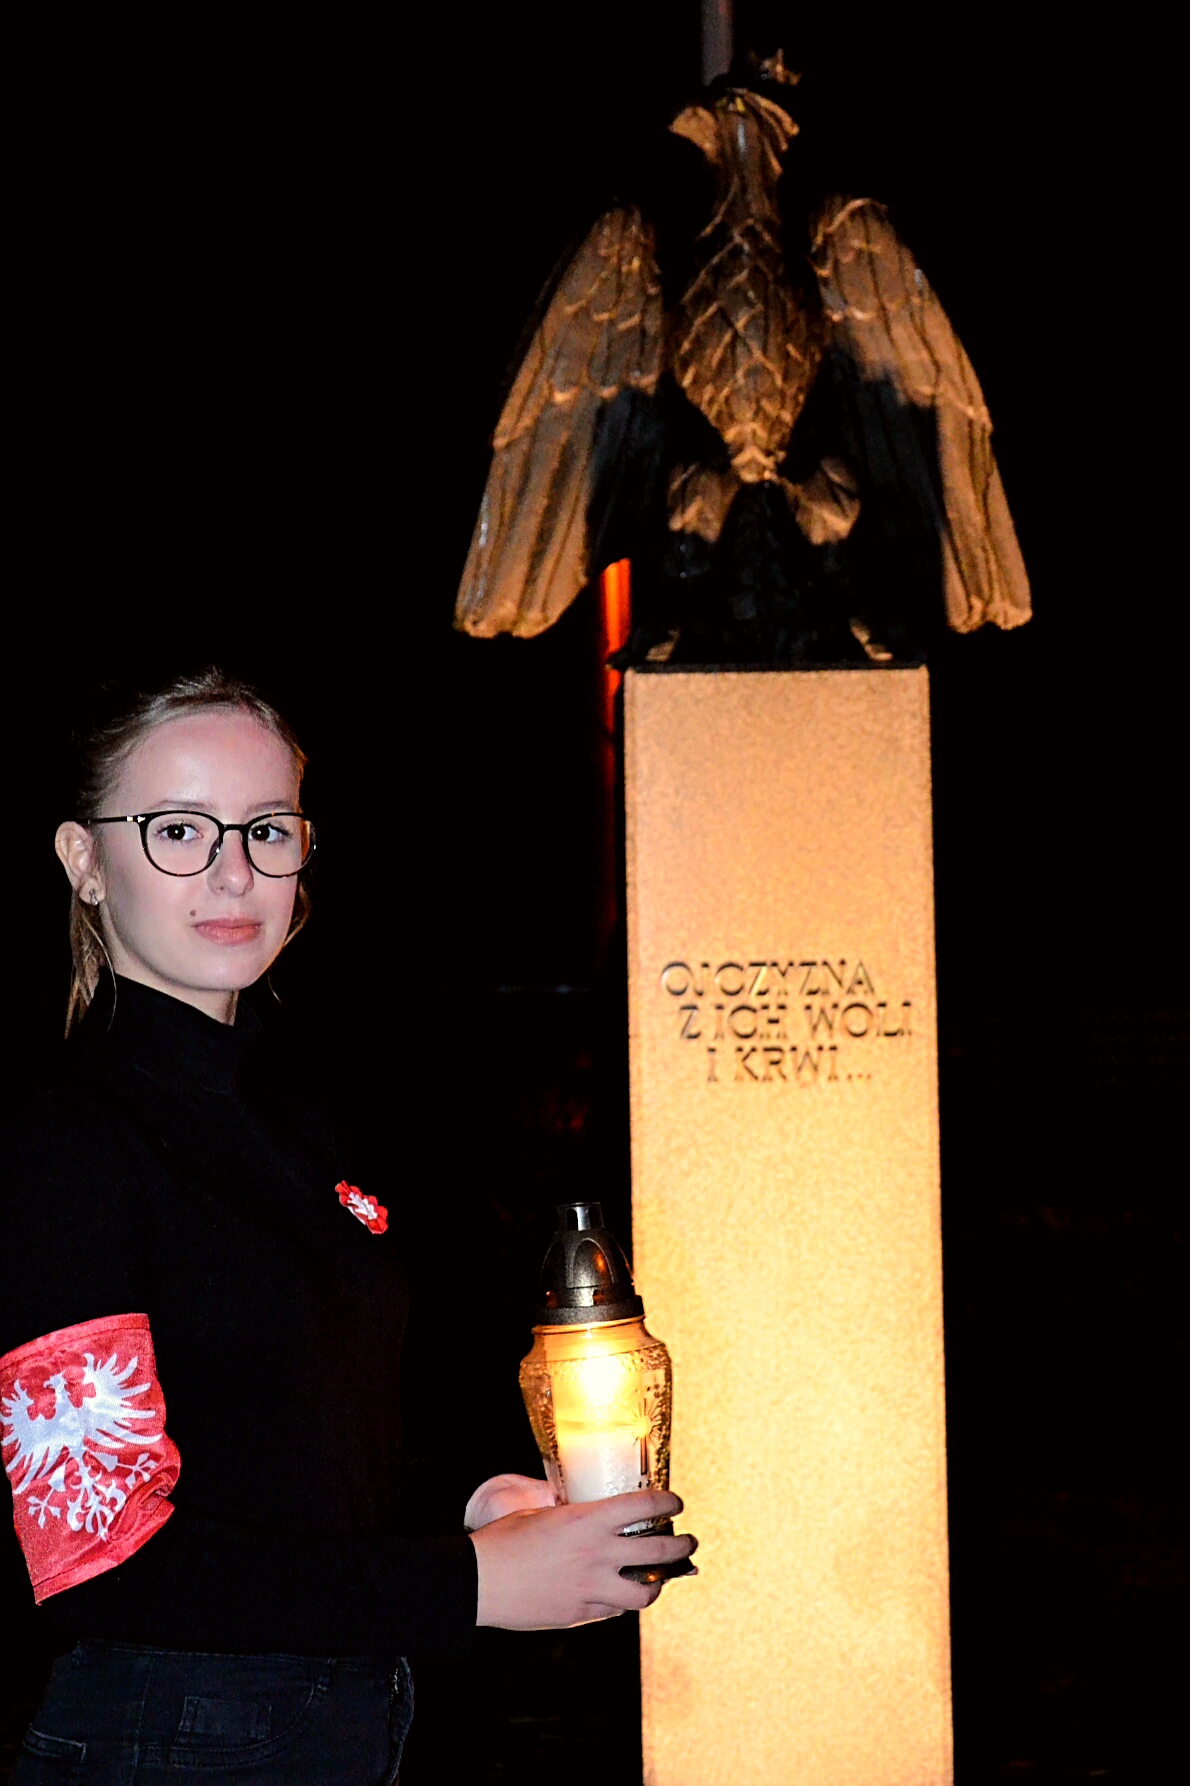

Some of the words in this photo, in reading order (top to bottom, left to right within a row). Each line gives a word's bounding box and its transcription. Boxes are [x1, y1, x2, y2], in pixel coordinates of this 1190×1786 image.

[660, 960, 875, 996] OJCZYZNA
[679, 1004, 702, 1039] Z
[714, 1003, 789, 1040] ICH
[804, 1001, 912, 1039] WOLI
[706, 1046, 719, 1082] I
